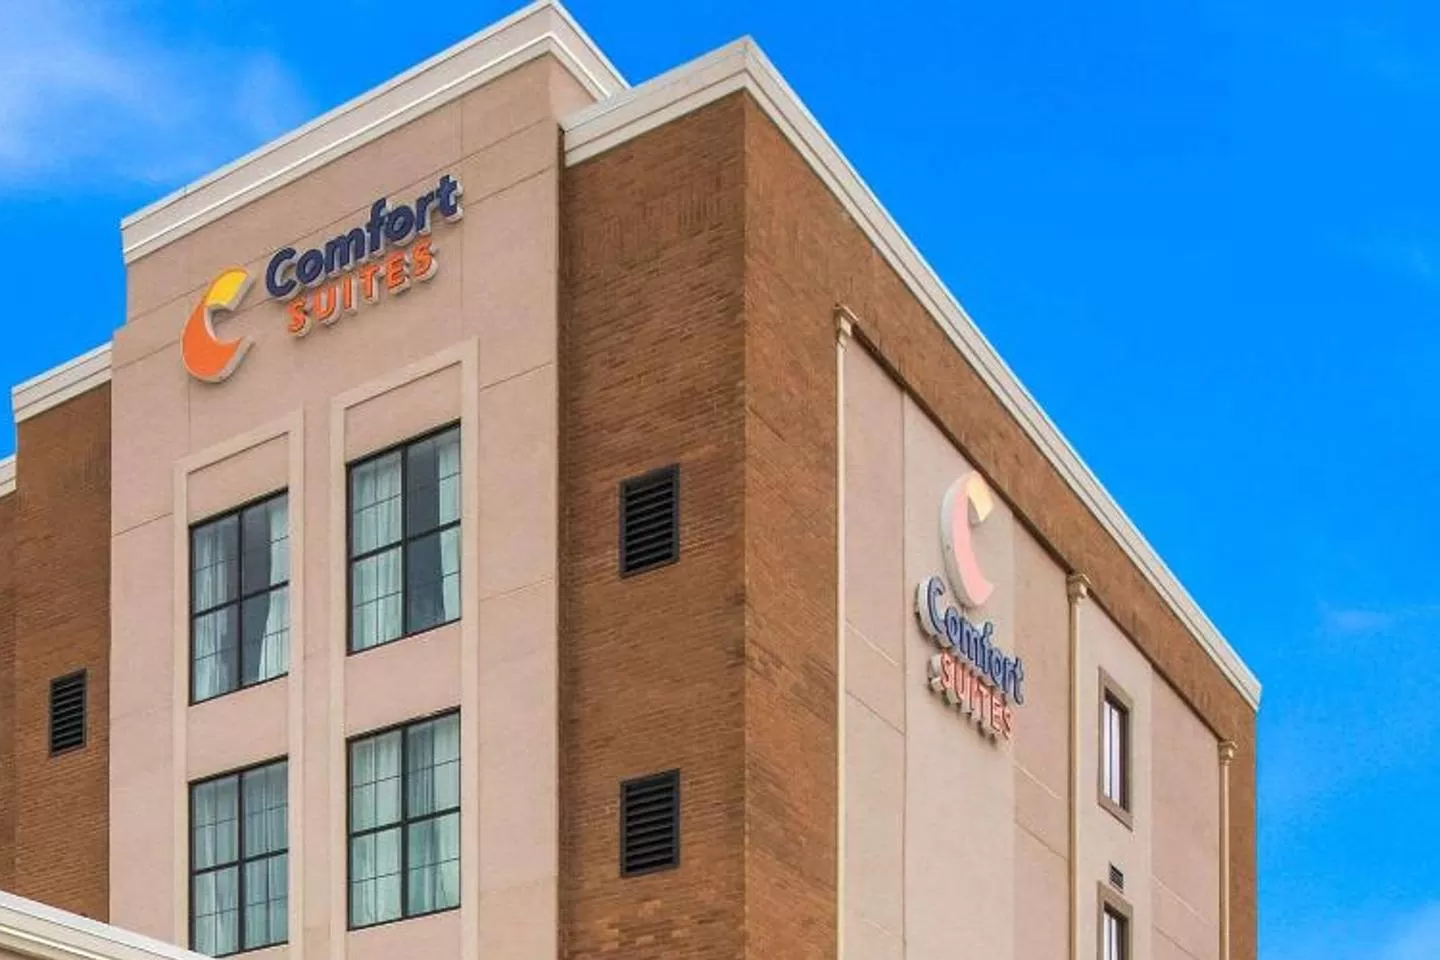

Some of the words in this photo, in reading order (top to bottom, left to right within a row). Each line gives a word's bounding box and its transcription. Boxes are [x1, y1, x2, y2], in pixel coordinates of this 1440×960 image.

[266, 174, 462, 299] Comfort
[287, 234, 435, 336] SUITES
[917, 576, 1024, 705] Comfort
[930, 651, 1015, 741] SUITES
